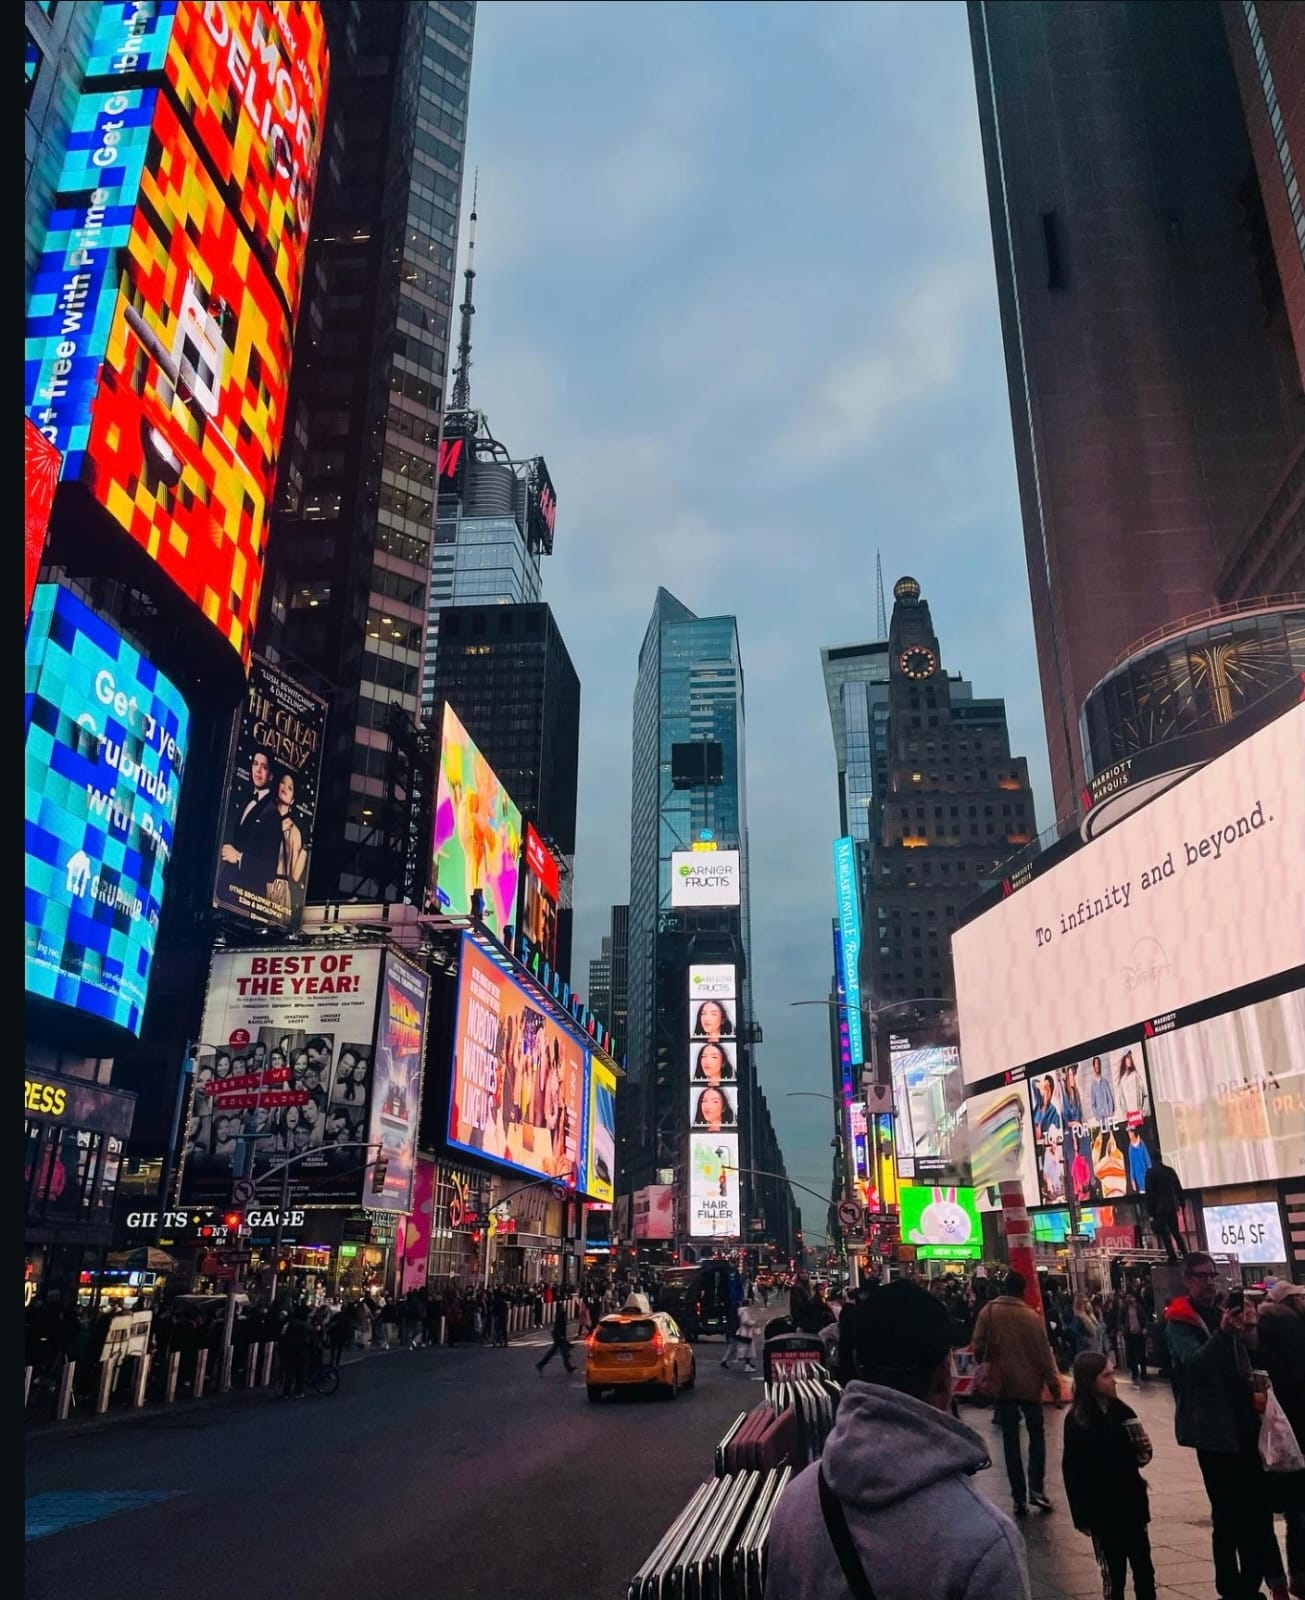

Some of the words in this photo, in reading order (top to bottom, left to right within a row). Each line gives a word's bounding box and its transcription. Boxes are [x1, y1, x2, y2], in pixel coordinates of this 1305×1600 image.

[92, 120, 124, 167] Get
[69, 187, 109, 266] Prime
[58, 273, 92, 335] with
[39, 340, 77, 400] free
[94, 669, 138, 726] Get
[143, 711, 156, 740] a
[253, 721, 311, 769] GATSBY
[275, 709, 318, 754] GREAT
[1092, 760, 1132, 792] MARRIOTT
[1093, 774, 1128, 801] MARQUIS
[86, 782, 137, 832] with
[685, 876, 730, 888] FRUCTIS
[838, 843, 856, 938] MARGARITAVILLE
[1035, 927, 1052, 947] To
[1060, 882, 1131, 934] infinity
[1141, 853, 1176, 890] and
[1184, 800, 1274, 865] beyond.
[237, 977, 285, 996] THE
[290, 975, 360, 995] YEAR!
[251, 956, 316, 975] BEST
[320, 954, 353, 974] OF
[845, 939, 859, 991] Resort
[467, 997, 498, 1055] NOBODY
[272, 1069, 287, 1079] WE
[462, 1036, 497, 1095] WATCHES
[220, 1097, 253, 1106] ROLL
[1072, 1123, 1089, 1139] FOR
[1100, 1117, 1119, 1133] LIFE
[126, 1211, 188, 1228] GIFTS
[697, 1209, 733, 1219] FILLER
[702, 1200, 728, 1209] HAIR
[1221, 1224, 1246, 1246] 654
[1249, 1223, 1265, 1245] SF
